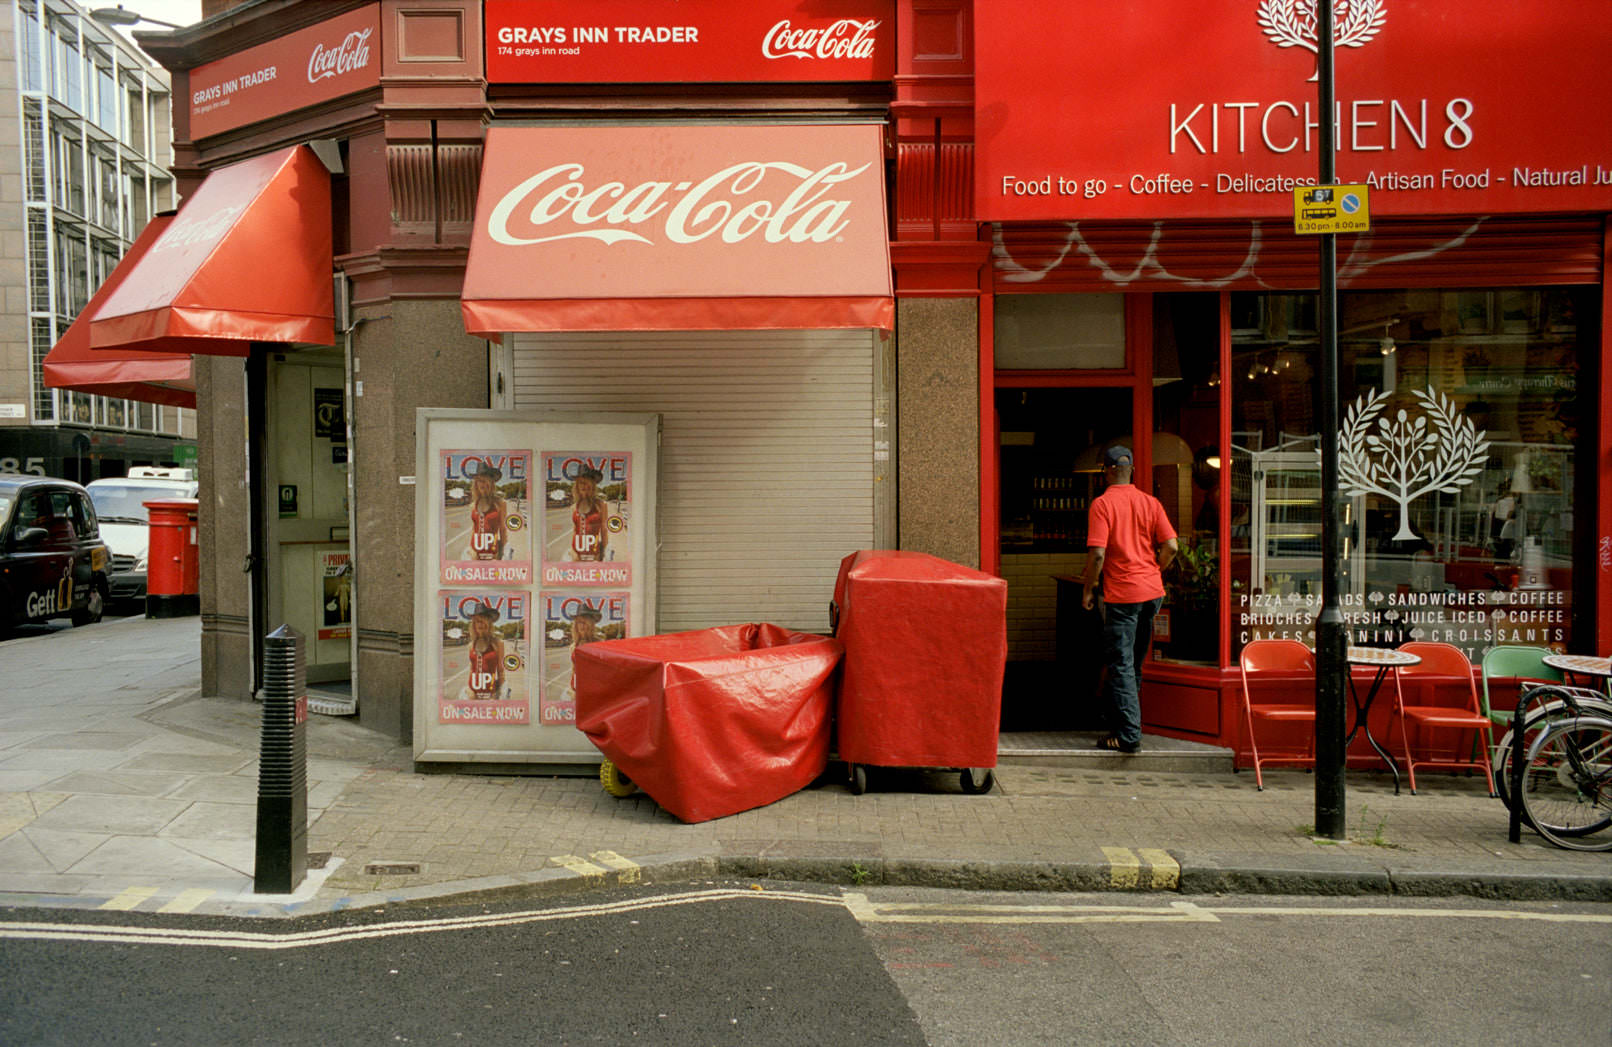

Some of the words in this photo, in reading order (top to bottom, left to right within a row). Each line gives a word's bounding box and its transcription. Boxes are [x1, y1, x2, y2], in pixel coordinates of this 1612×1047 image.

[498, 27, 567, 44] GRAYS
[573, 27, 609, 43] INN
[615, 26, 699, 43] TRADER
[761, 18, 882, 60] Coca-Cola
[307, 24, 375, 84] Coca-Cola
[498, 47, 513, 55] 174
[515, 47, 540, 57] grays
[542, 46, 557, 55] inn
[558, 46, 580, 55] road
[193, 84, 221, 105] GRAYS
[222, 79, 238, 96] INN
[239, 66, 277, 89] TRADER
[1170, 98, 1428, 154] KITCHEN
[1443, 98, 1474, 150] 8
[1002, 174, 1051, 196] Food
[1058, 177, 1078, 195] to
[1083, 179, 1107, 199] go
[1129, 173, 1194, 195] Coffee
[1216, 171, 1341, 194] Delicatess
[1365, 170, 1434, 191] Artisan
[1441, 168, 1490, 189] Food
[1513, 165, 1586, 187] Natural
[487, 160, 873, 247] Coca-Cola
[445, 455, 526, 480] LOVE
[547, 457, 627, 482] LOVE
[473, 532, 499, 551] UP!
[575, 534, 600, 552] UP!
[445, 566, 462, 581] ON
[465, 567, 496, 581] SALE
[498, 567, 528, 581] NOW
[546, 567, 563, 582] ON
[566, 568, 597, 582] SALE
[600, 568, 628, 583] NOW
[26, 588, 56, 618] Gett
[444, 596, 525, 620] LOVE
[547, 597, 625, 621] LOVE
[1240, 594, 1282, 607] PIZZA
[1306, 593, 1363, 607] SADS
[1388, 592, 1486, 606] SANDWICHES
[1509, 592, 1564, 605] COFFEE
[1240, 612, 1312, 626] BRIOCHES
[1343, 611, 1382, 625] RESH
[1401, 611, 1444, 624] JUICE
[1452, 610, 1486, 624] ICED
[1509, 610, 1564, 623] COFFEE
[1240, 631, 1303, 644] CAKES
[1346, 629, 1404, 643] ANINI
[1431, 628, 1564, 642] CROISSANTS
[471, 672, 497, 691] UP!
[443, 705, 460, 720] ON
[463, 706, 493, 720] SALE
[496, 706, 525, 720] NOW
[545, 706, 562, 721] ON
